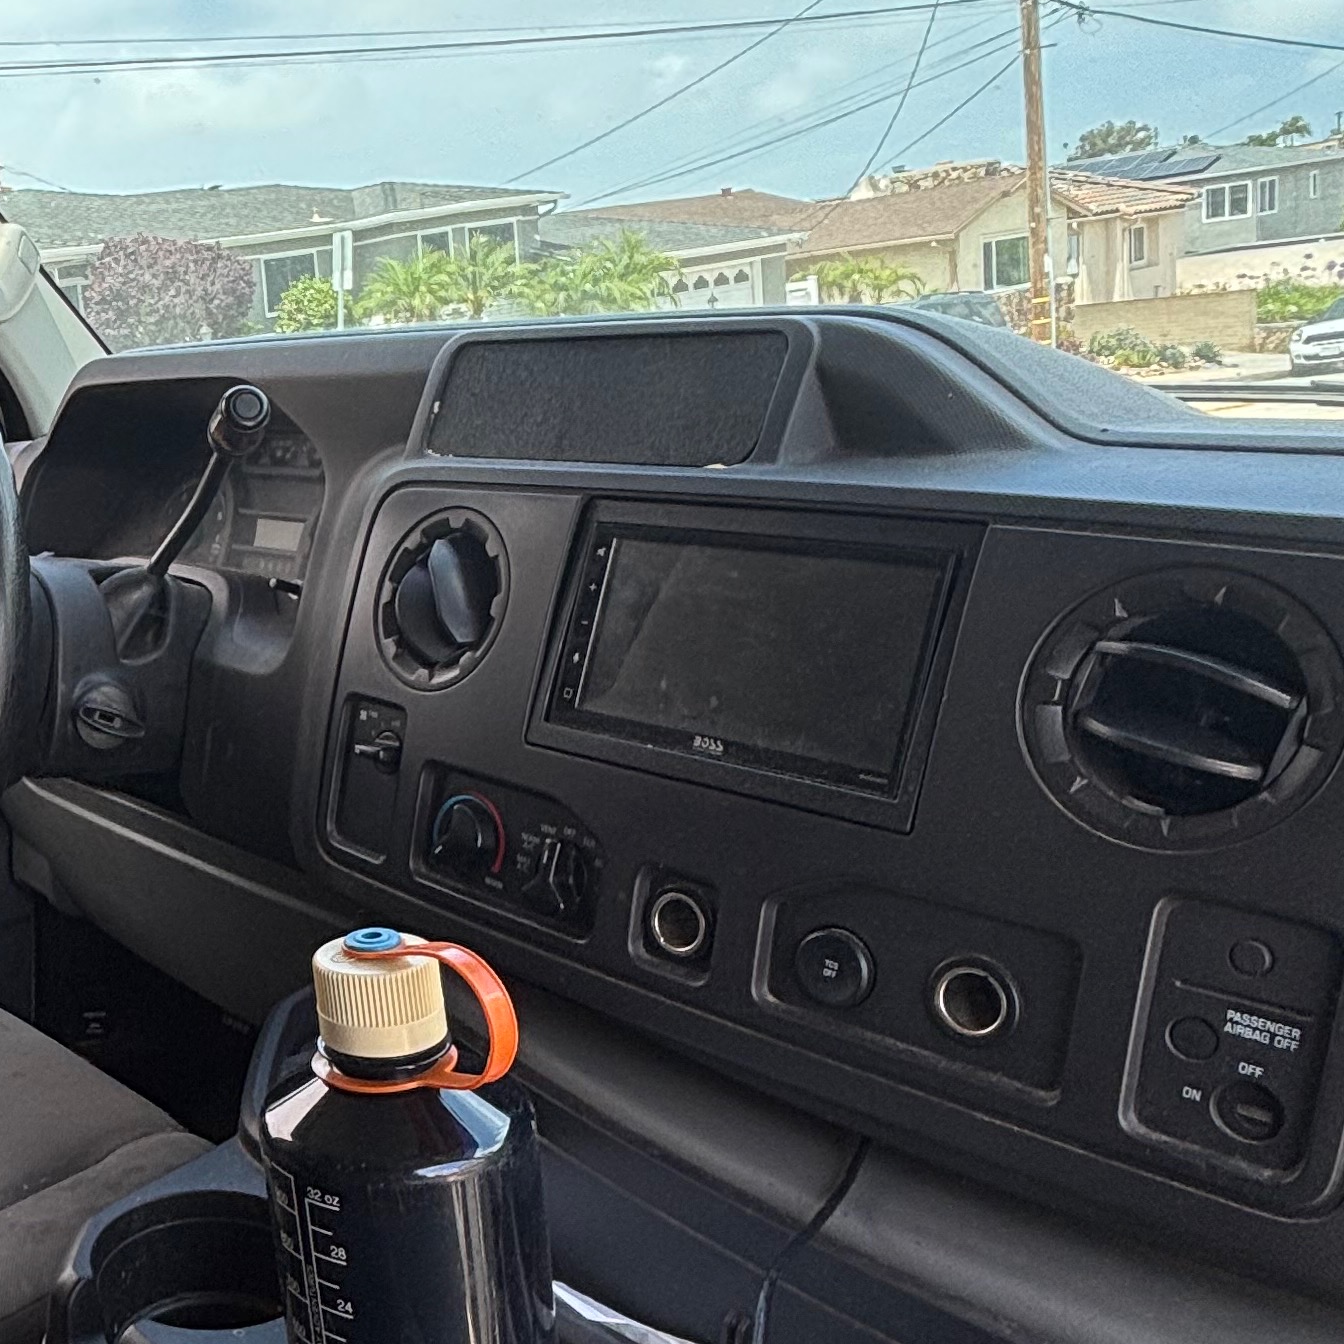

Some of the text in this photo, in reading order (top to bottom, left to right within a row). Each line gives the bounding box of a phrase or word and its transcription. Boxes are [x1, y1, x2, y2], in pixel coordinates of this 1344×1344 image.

[693, 735, 724, 752] BOSS
[1226, 1009, 1303, 1040] PASSENGER
[1223, 1022, 1299, 1052] AIRBAG OFF
[1238, 1061, 1264, 1079] OFF
[1182, 1086, 1202, 1102] ON
[306, 1186, 340, 1206] 32 oz
[330, 1245, 347, 1260] 28
[336, 1299, 353, 1314] 24
